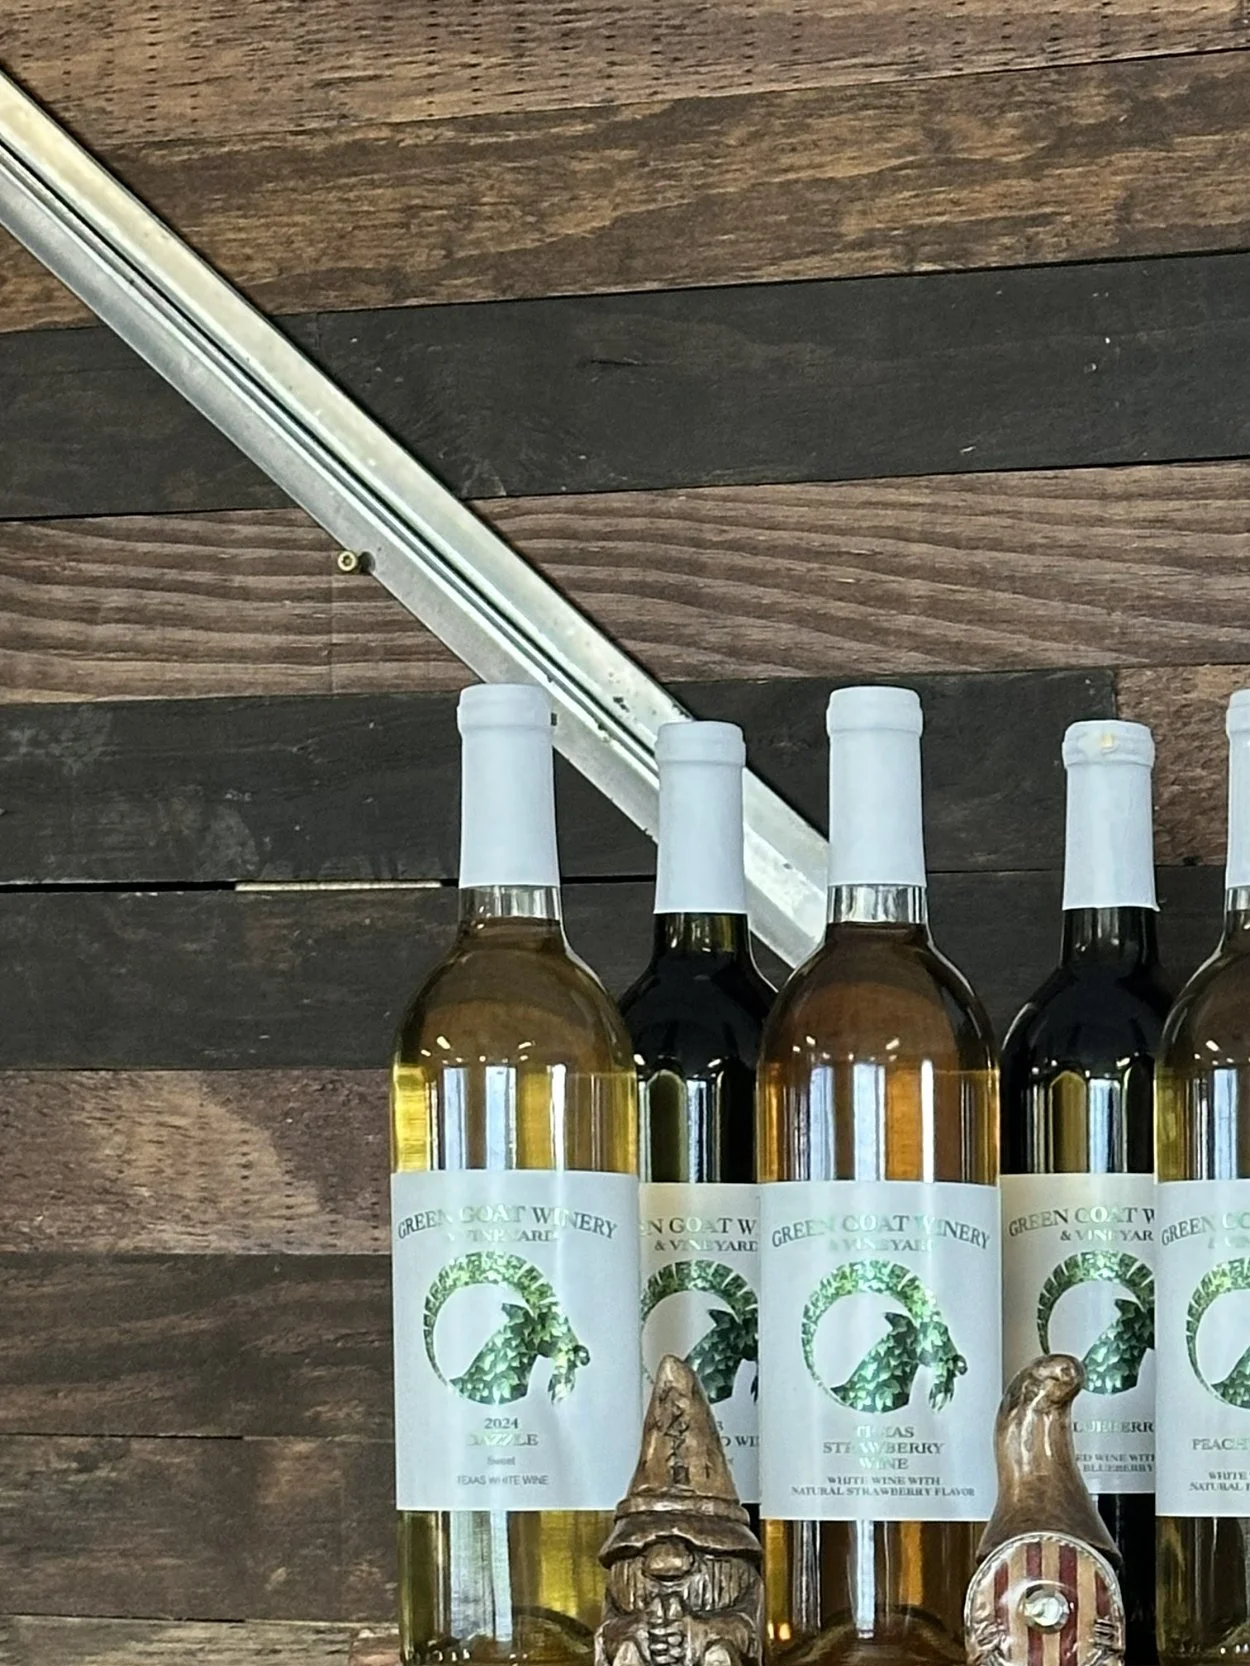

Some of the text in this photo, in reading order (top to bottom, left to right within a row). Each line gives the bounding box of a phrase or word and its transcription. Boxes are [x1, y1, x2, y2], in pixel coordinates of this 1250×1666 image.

[398, 1208, 452, 1239] GREEN
[460, 1204, 526, 1224] GOAT
[531, 1206, 618, 1240] WINERY
[668, 1217, 732, 1234] GOAT
[1008, 1209, 1069, 1237] GREEN
[1075, 1206, 1138, 1223] GOAT
[771, 1216, 835, 1248] GREEN
[842, 1215, 910, 1232] GOAT
[914, 1215, 990, 1250] WINERY
[1060, 1230, 1154, 1241] & VINEYAR
[1161, 1216, 1216, 1246] GREEN
[654, 1240, 665, 1251] &
[1073, 1421, 1154, 1433] LUEBERR
[735, 1435, 759, 1447] WI
[823, 1442, 944, 1454] STRWBERRY
[859, 1457, 909, 1470] WINE
[1076, 1453, 1092, 1462] ED
[1094, 1453, 1127, 1462] WINE
[457, 1475, 549, 1485] TEXAS WHITE WINE
[871, 1476, 906, 1485] WINE
[907, 1476, 941, 1485] WITH
[1208, 1472, 1247, 1480] WHITE
[791, 1486, 975, 1496] NATURAL STRAWBERRY FLAVOR
[1189, 1482, 1243, 1491] NATURAL
